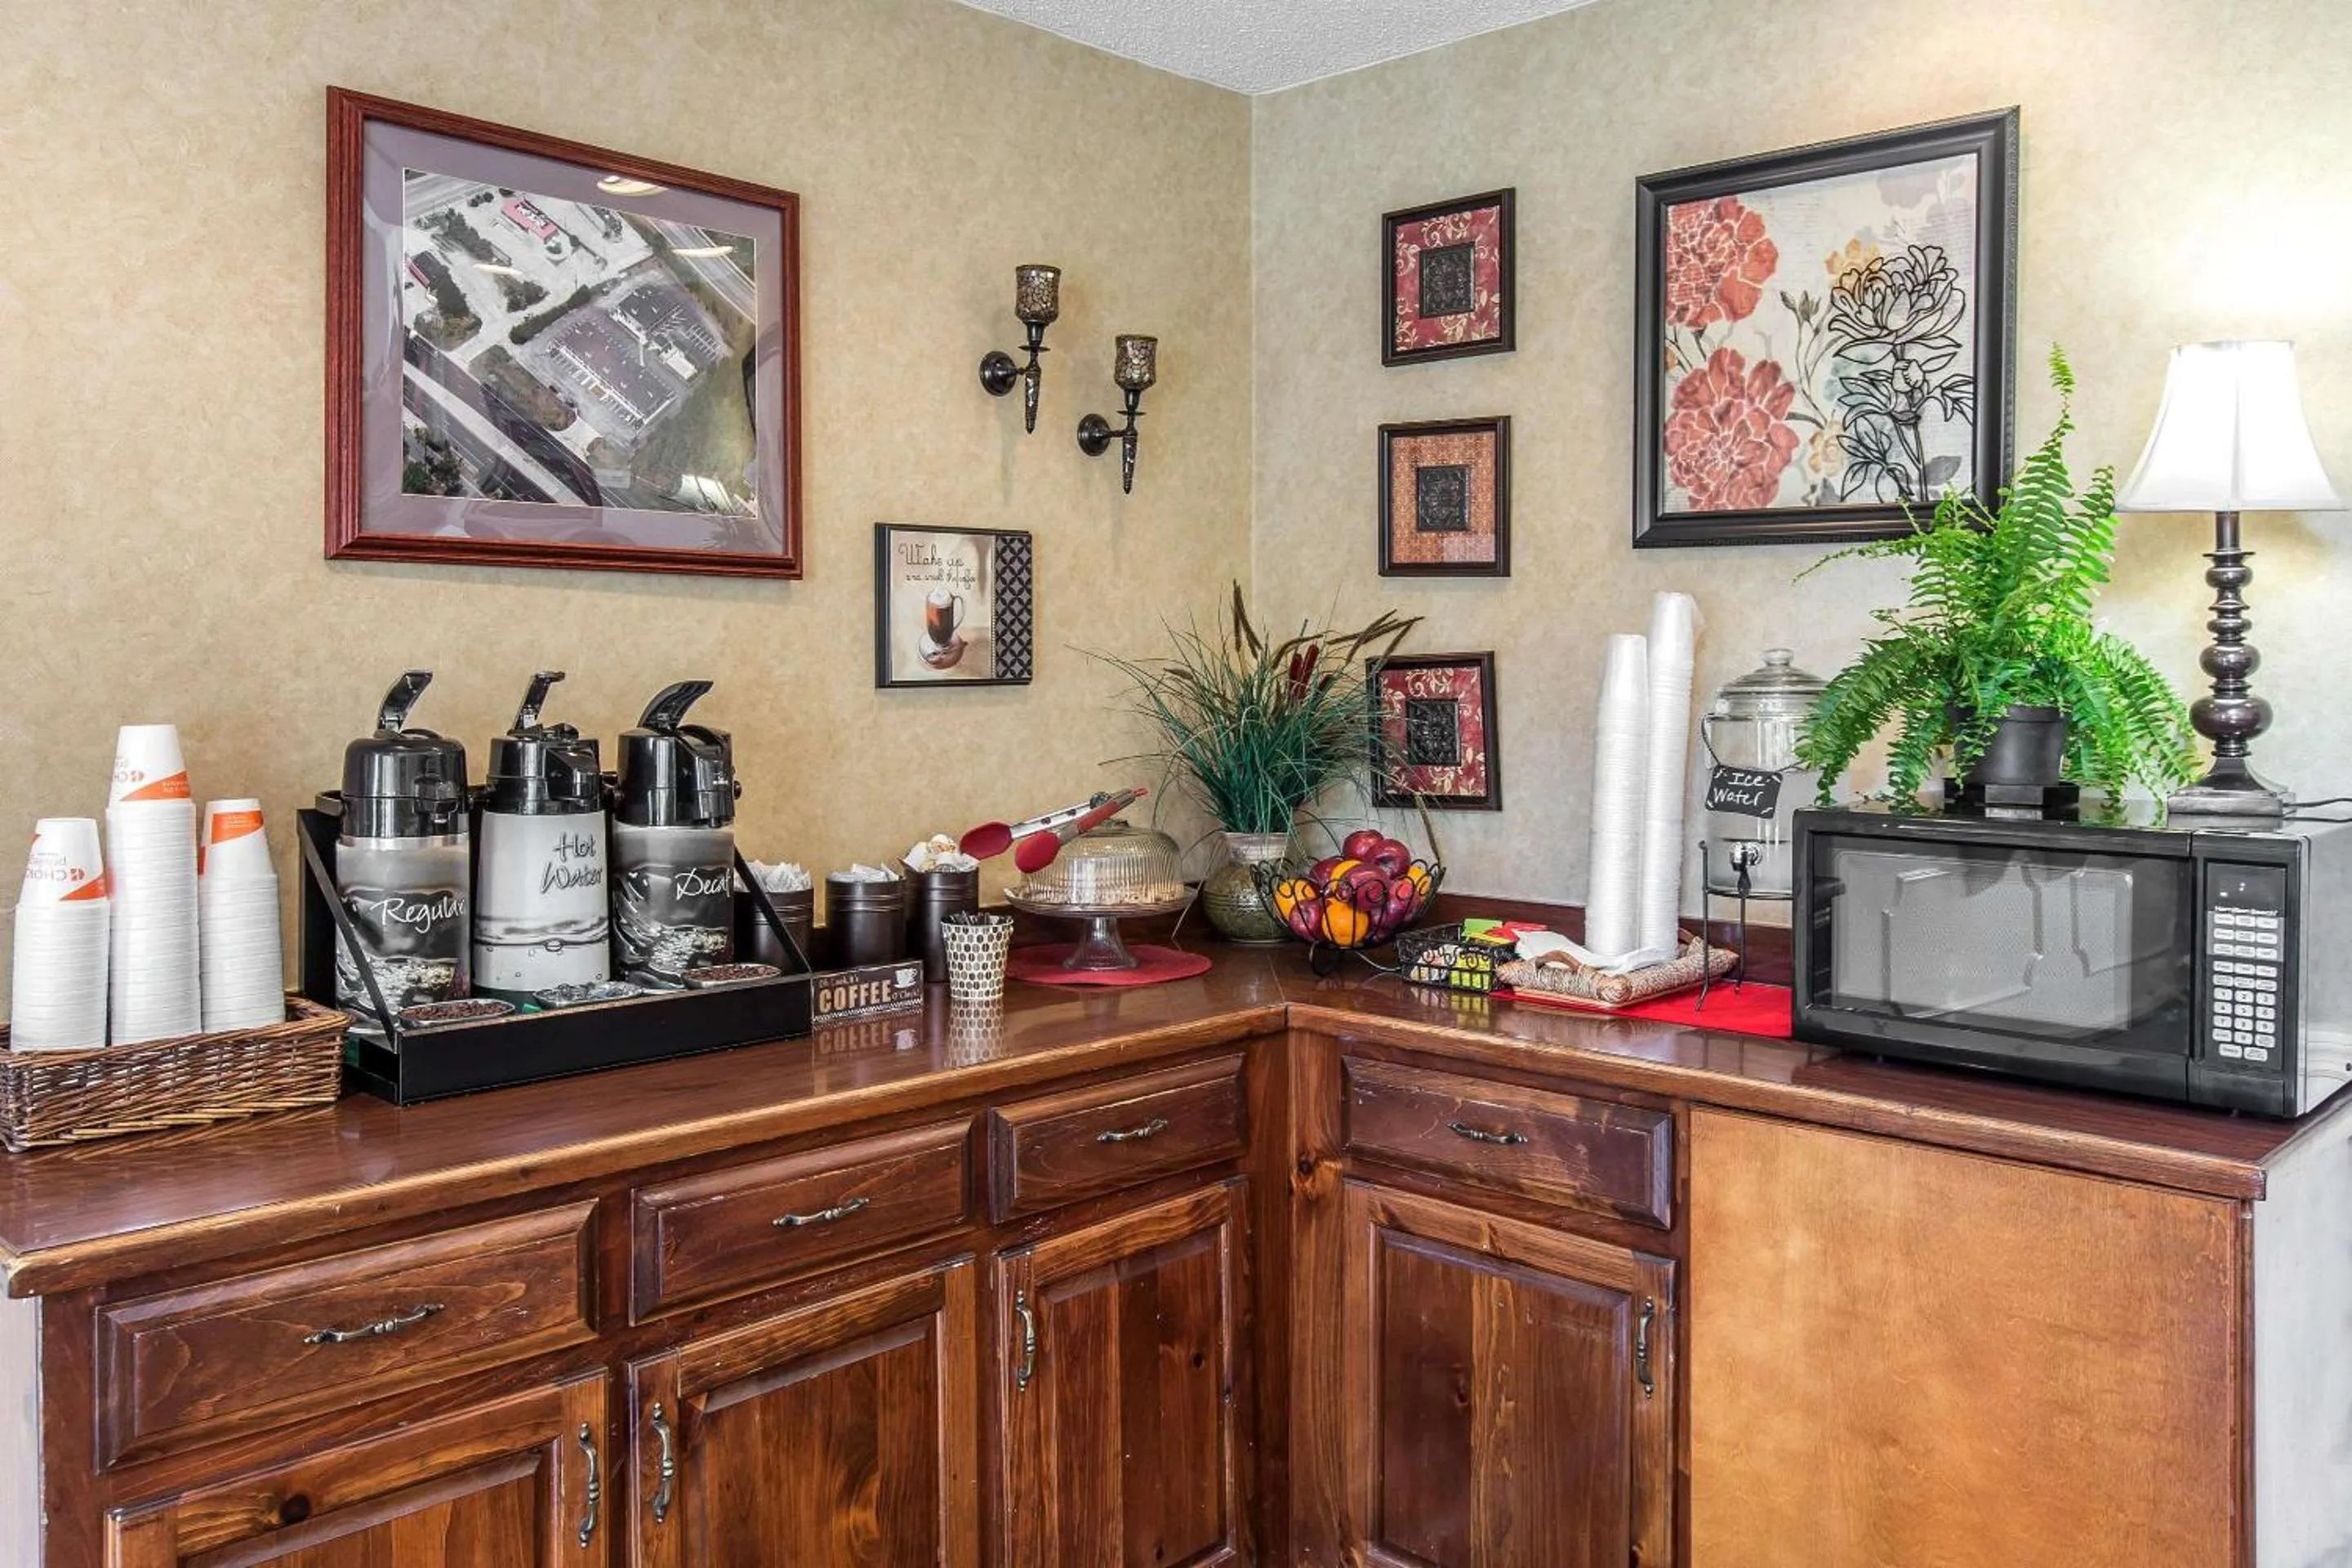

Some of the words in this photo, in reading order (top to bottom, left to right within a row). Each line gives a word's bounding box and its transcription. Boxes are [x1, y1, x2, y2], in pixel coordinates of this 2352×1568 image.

[1728, 773, 1766, 786] Ice
[1713, 788, 1764, 807] Water
[552, 833, 596, 862] Hot
[540, 862, 603, 894] Water
[675, 868, 731, 900] Decaf
[369, 897, 465, 934] Regular
[819, 979, 892, 1013] COFFEE
